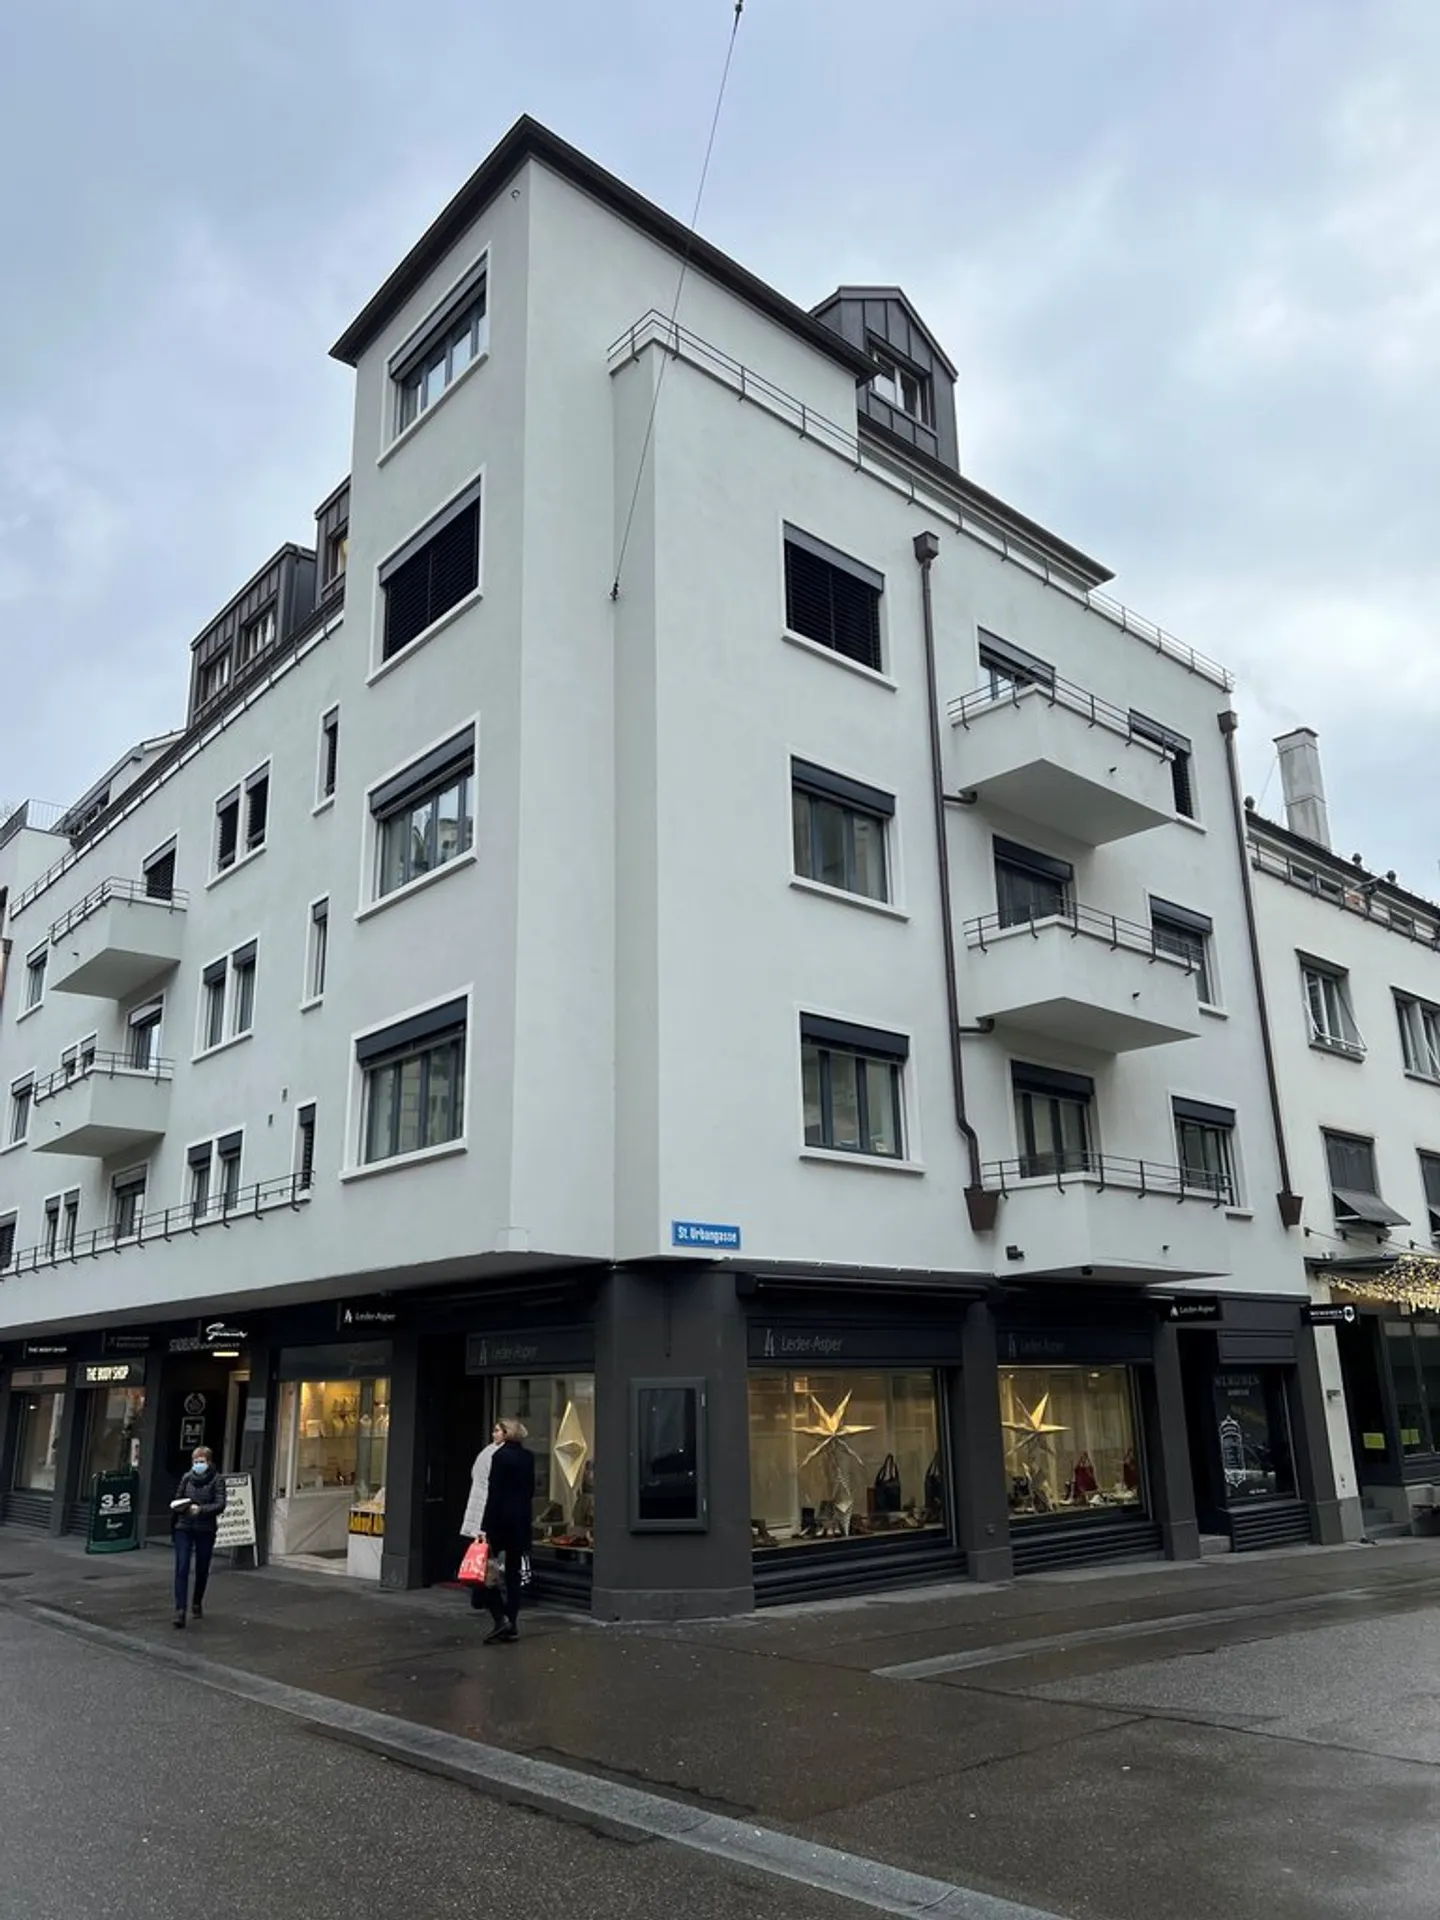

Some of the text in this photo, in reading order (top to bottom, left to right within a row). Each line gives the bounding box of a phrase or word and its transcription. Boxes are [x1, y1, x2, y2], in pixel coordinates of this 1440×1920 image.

[677, 1226, 737, 1244] St. Urbangasse
[86, 1366, 97, 1381] THE
[112, 1365, 129, 1380] SHOP
